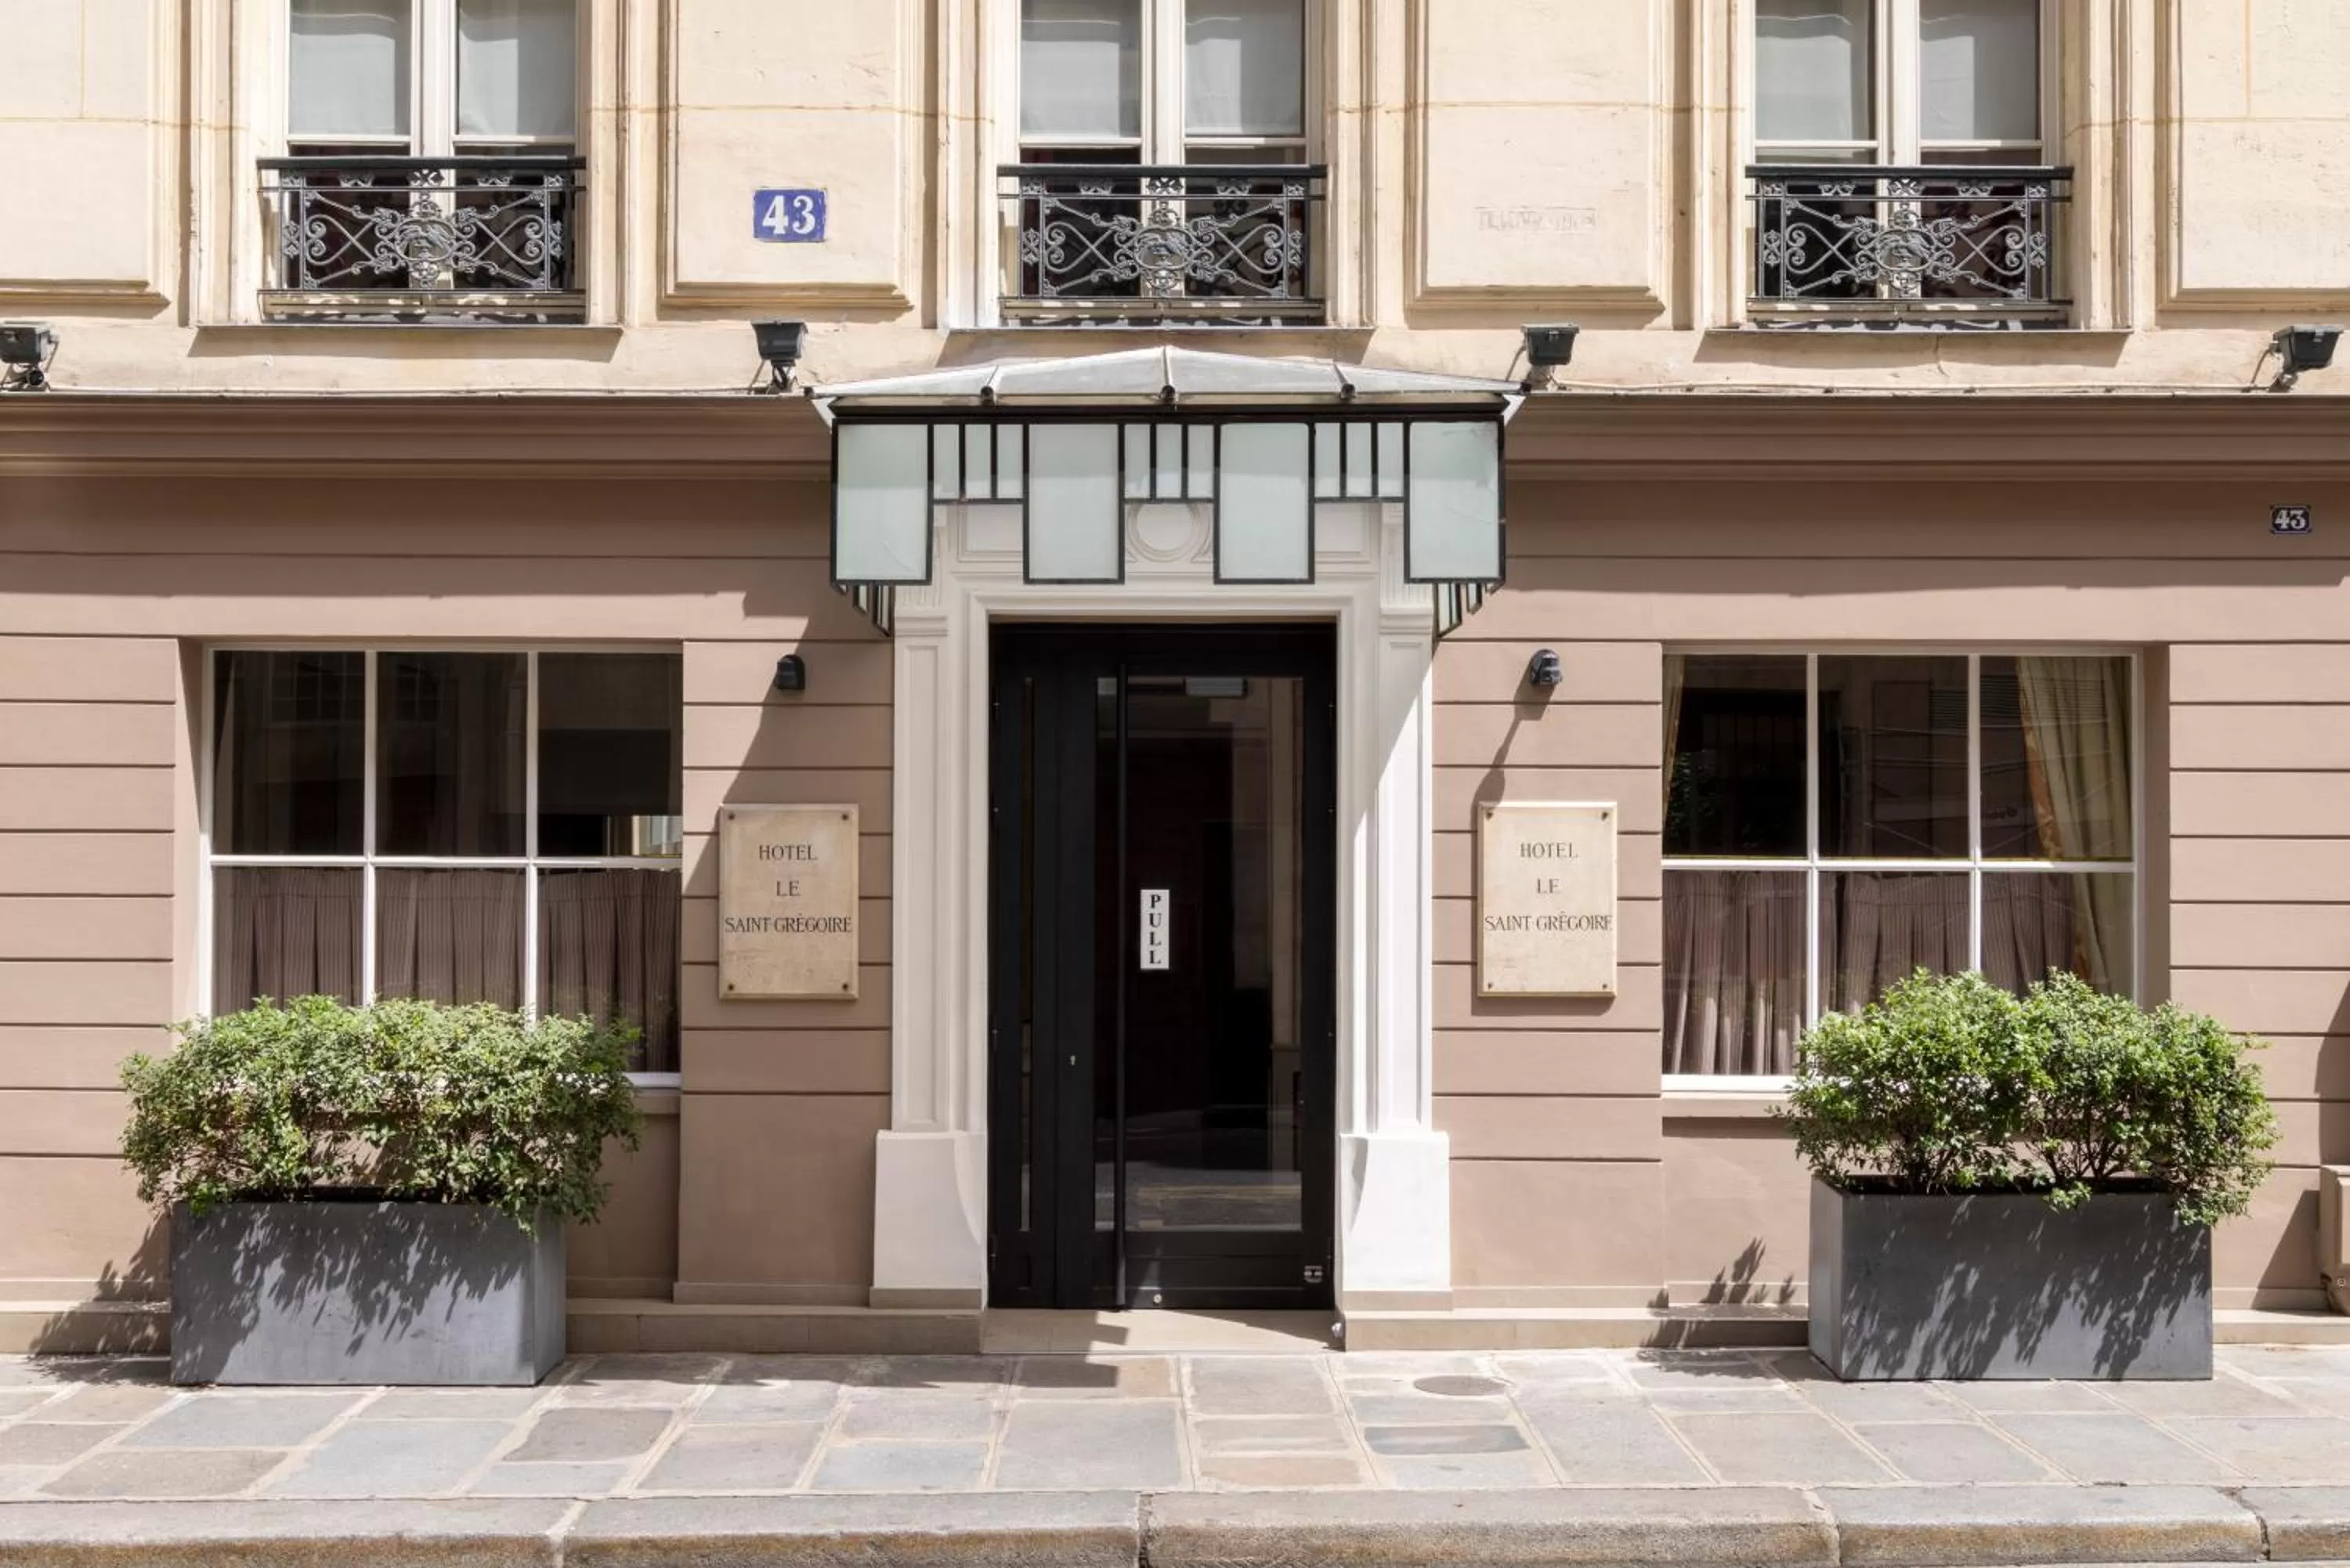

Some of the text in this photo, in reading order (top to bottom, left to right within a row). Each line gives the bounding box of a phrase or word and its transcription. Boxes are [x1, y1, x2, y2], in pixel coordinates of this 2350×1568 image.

[762, 195, 815, 234] 43
[2275, 510, 2306, 529] 43
[759, 844, 818, 861] HOTEL
[1520, 842, 1578, 858] HOTEL
[776, 880, 801, 897] LE
[1537, 878, 1560, 894] LE
[1148, 894, 1162, 964] PULL
